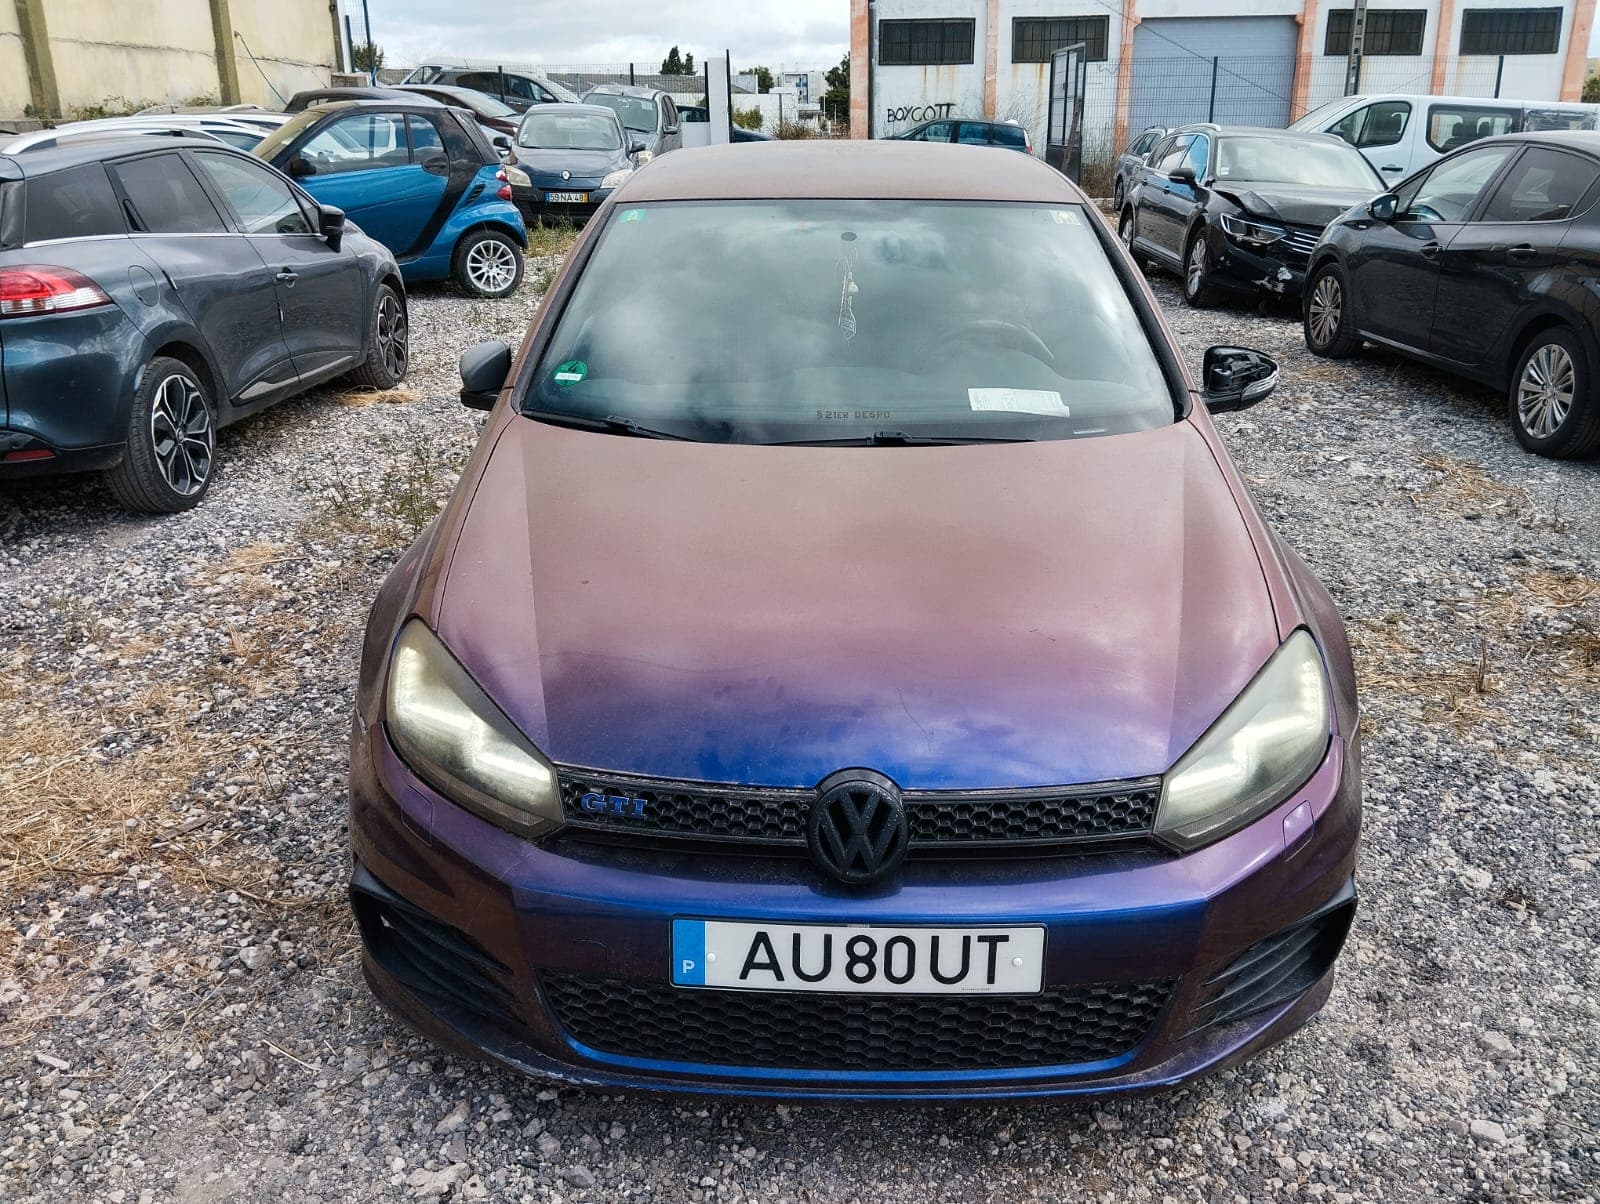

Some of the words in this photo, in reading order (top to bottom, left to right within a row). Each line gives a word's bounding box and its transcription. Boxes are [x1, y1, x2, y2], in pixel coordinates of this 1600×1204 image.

[887, 103, 956, 122] BOYCOTT
[581, 792, 647, 816] GTI
[682, 959, 695, 974] P
